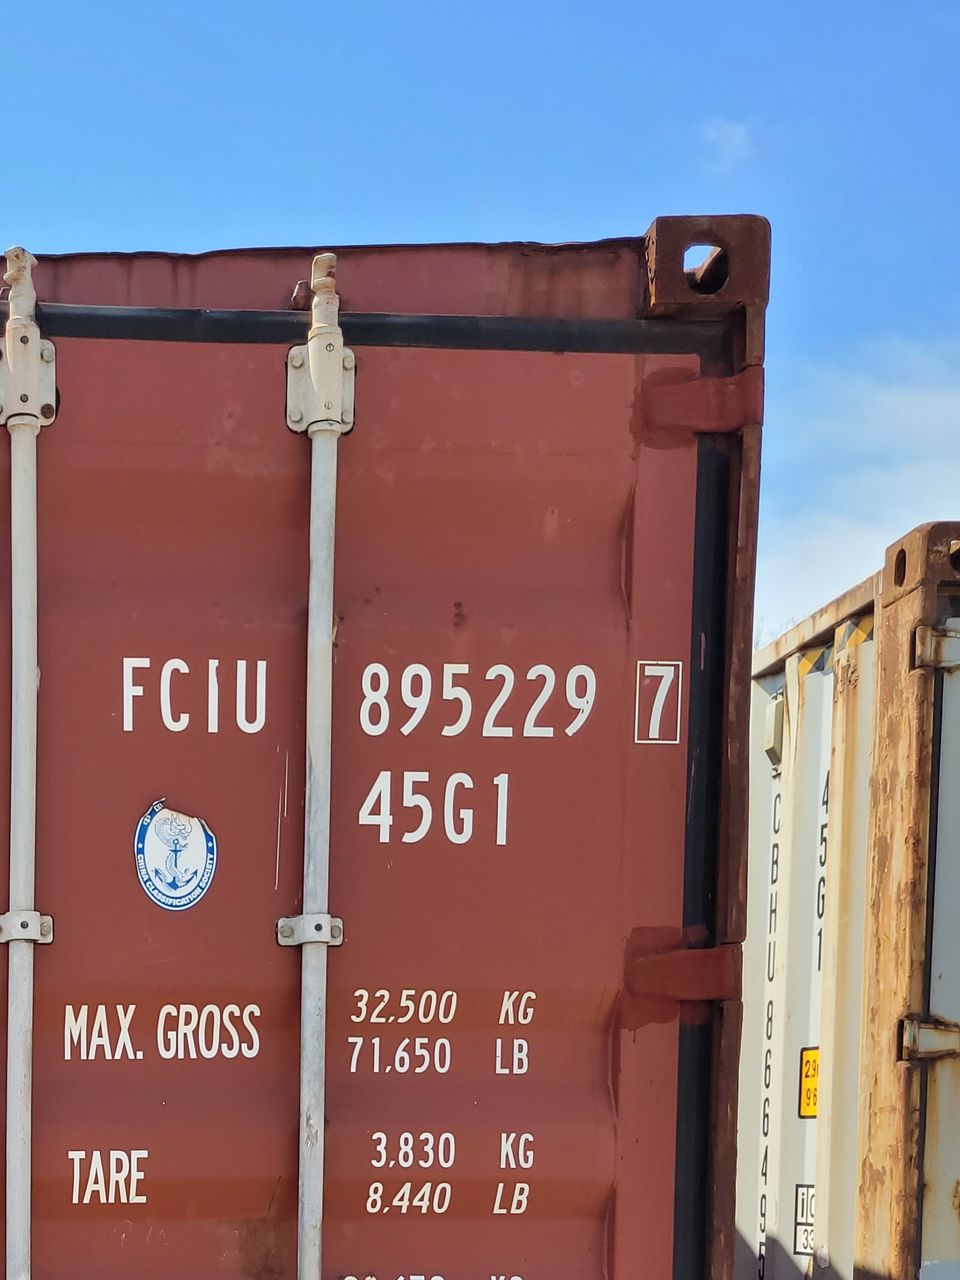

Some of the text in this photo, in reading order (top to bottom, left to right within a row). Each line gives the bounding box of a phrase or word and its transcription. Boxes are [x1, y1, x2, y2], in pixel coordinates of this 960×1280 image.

[122, 657, 675, 739] FCIU 895229 7
[358, 771, 510, 845] 45G1
[137, 853, 215, 906] CHINA CLASSIFICATION SOCIETY
[767, 793, 782, 983] CBHU
[816, 769, 831, 973] 45G1
[64, 1004, 261, 1060] MAX. GROSS
[350, 989, 537, 1025] 32,500 KG
[347, 1037, 529, 1075] 71,650 LB
[67, 1149, 149, 1204] TARE
[370, 1132, 535, 1169] 3,830 KG
[365, 1182, 531, 1214] 8,440 LB
